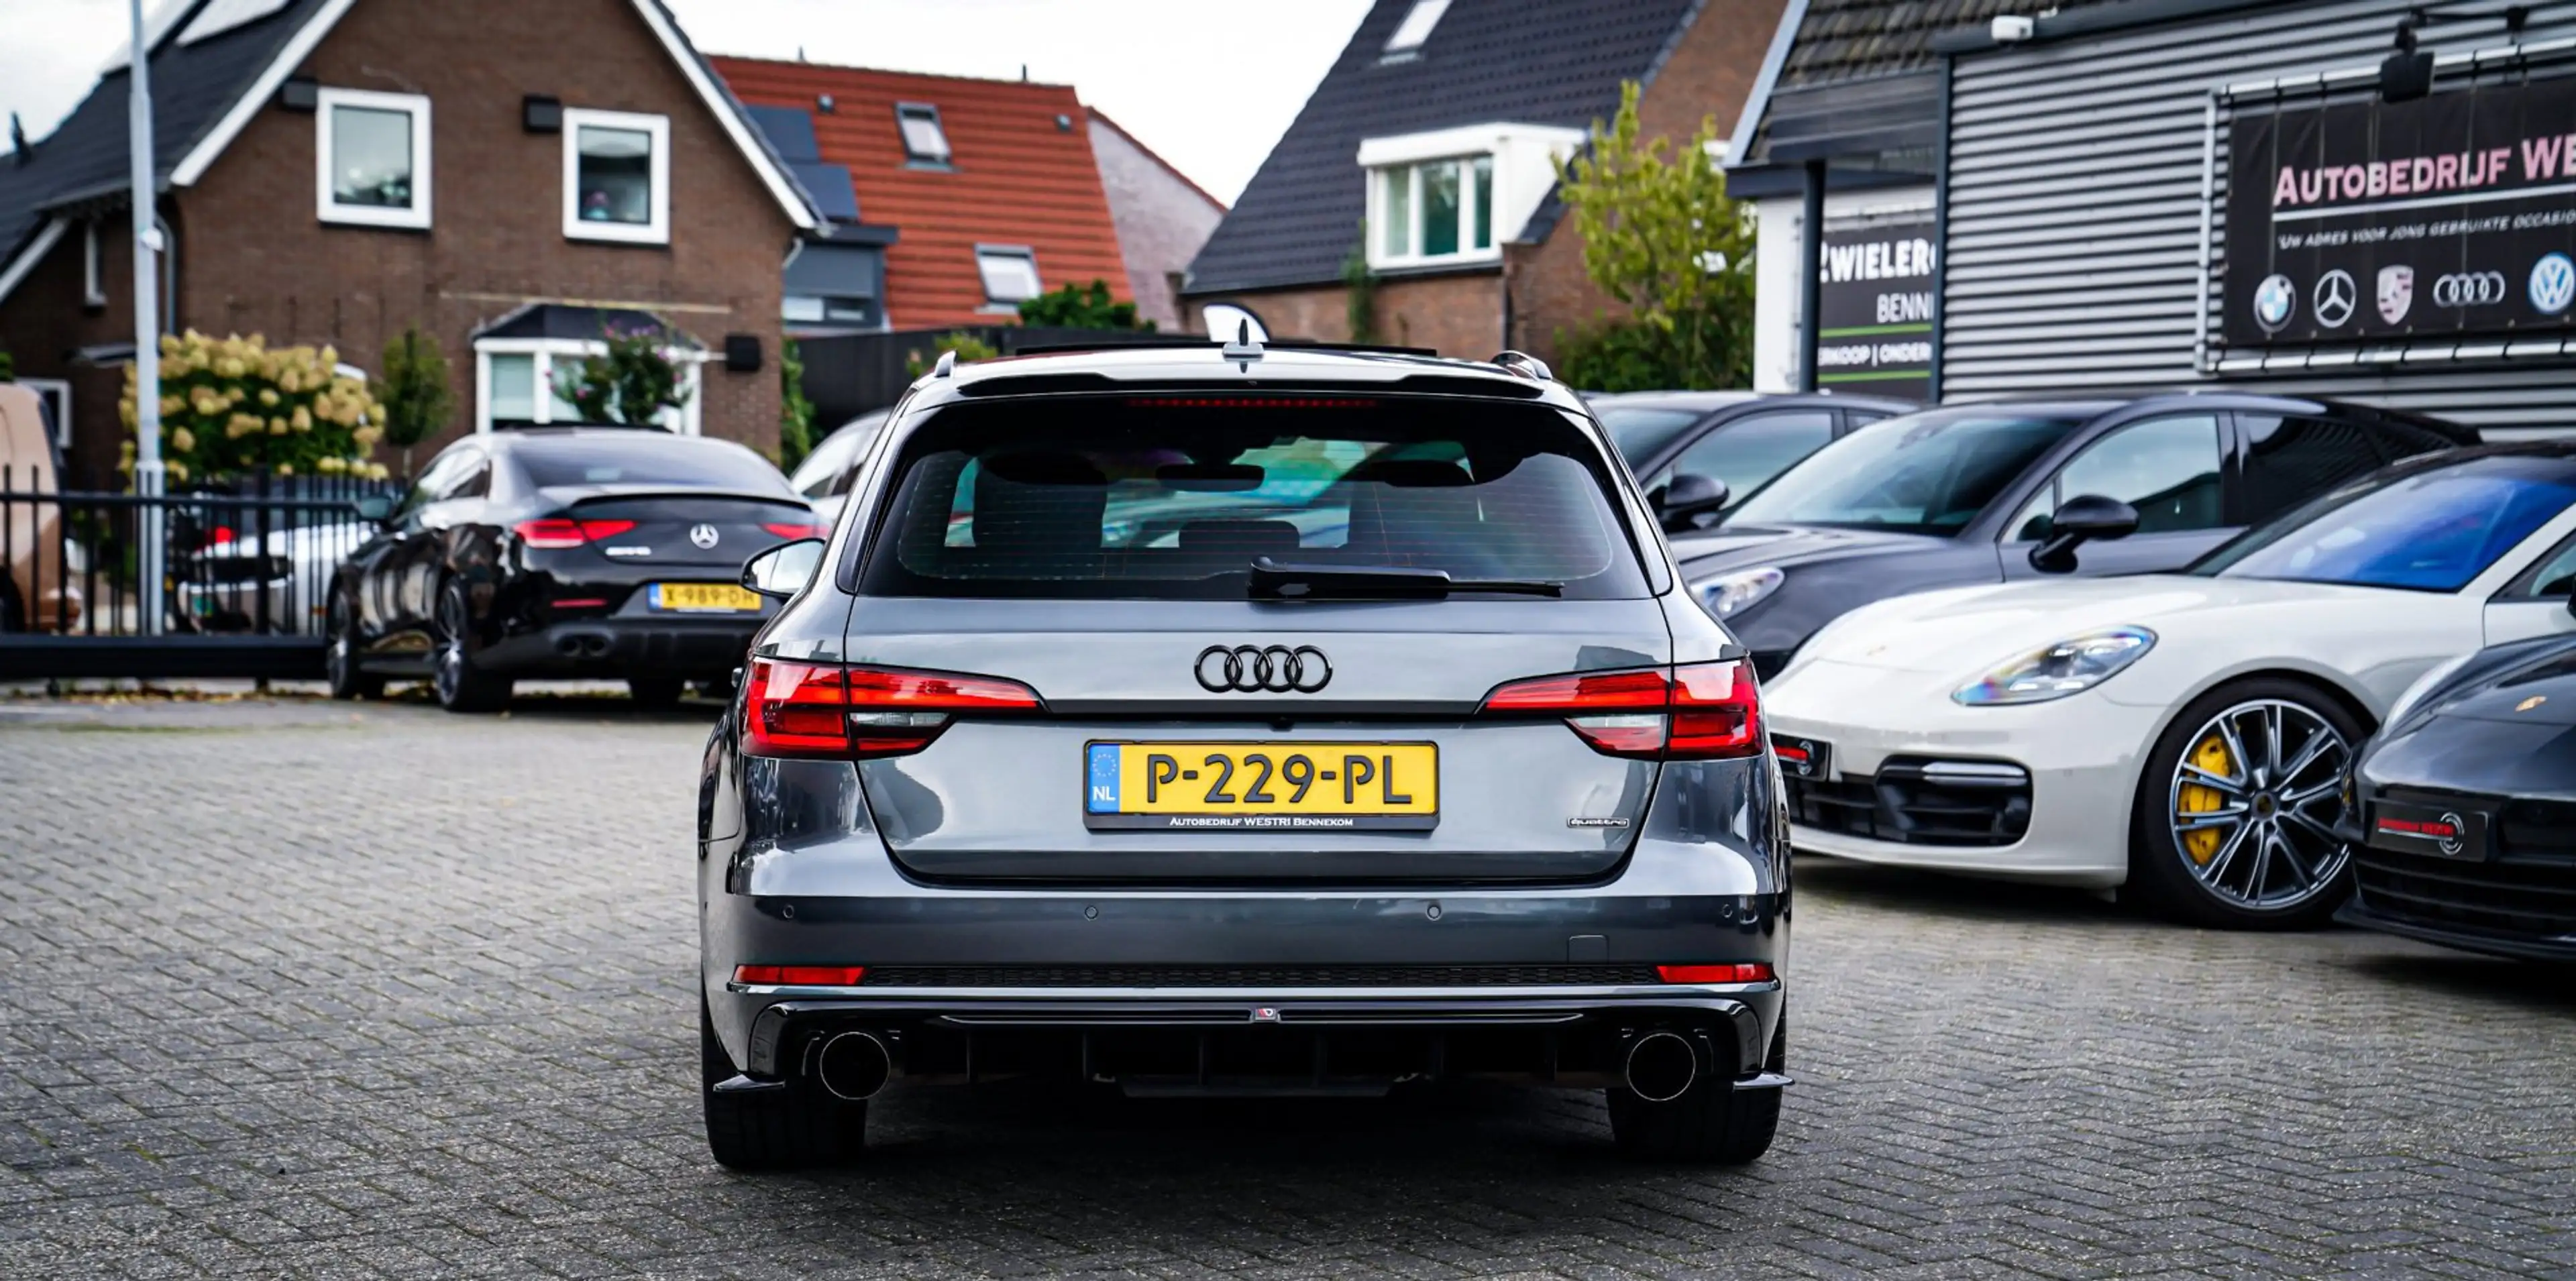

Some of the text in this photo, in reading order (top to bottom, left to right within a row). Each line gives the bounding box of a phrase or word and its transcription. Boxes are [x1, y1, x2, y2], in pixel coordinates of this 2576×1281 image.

[2273, 133, 2576, 207] AUTOBEDRIJF WE
[2305, 229, 2349, 247] ADRES
[2351, 226, 2387, 243] VOOR
[2389, 222, 2426, 241] JONG
[2428, 215, 2510, 236] GEBRUIKTE
[1877, 292, 1935, 324] BENN
[1093, 754, 1412, 804] NL P-229-PL
[1169, 817, 1354, 826] AUTOBEDRIJF WESTRI BENNEKOM
